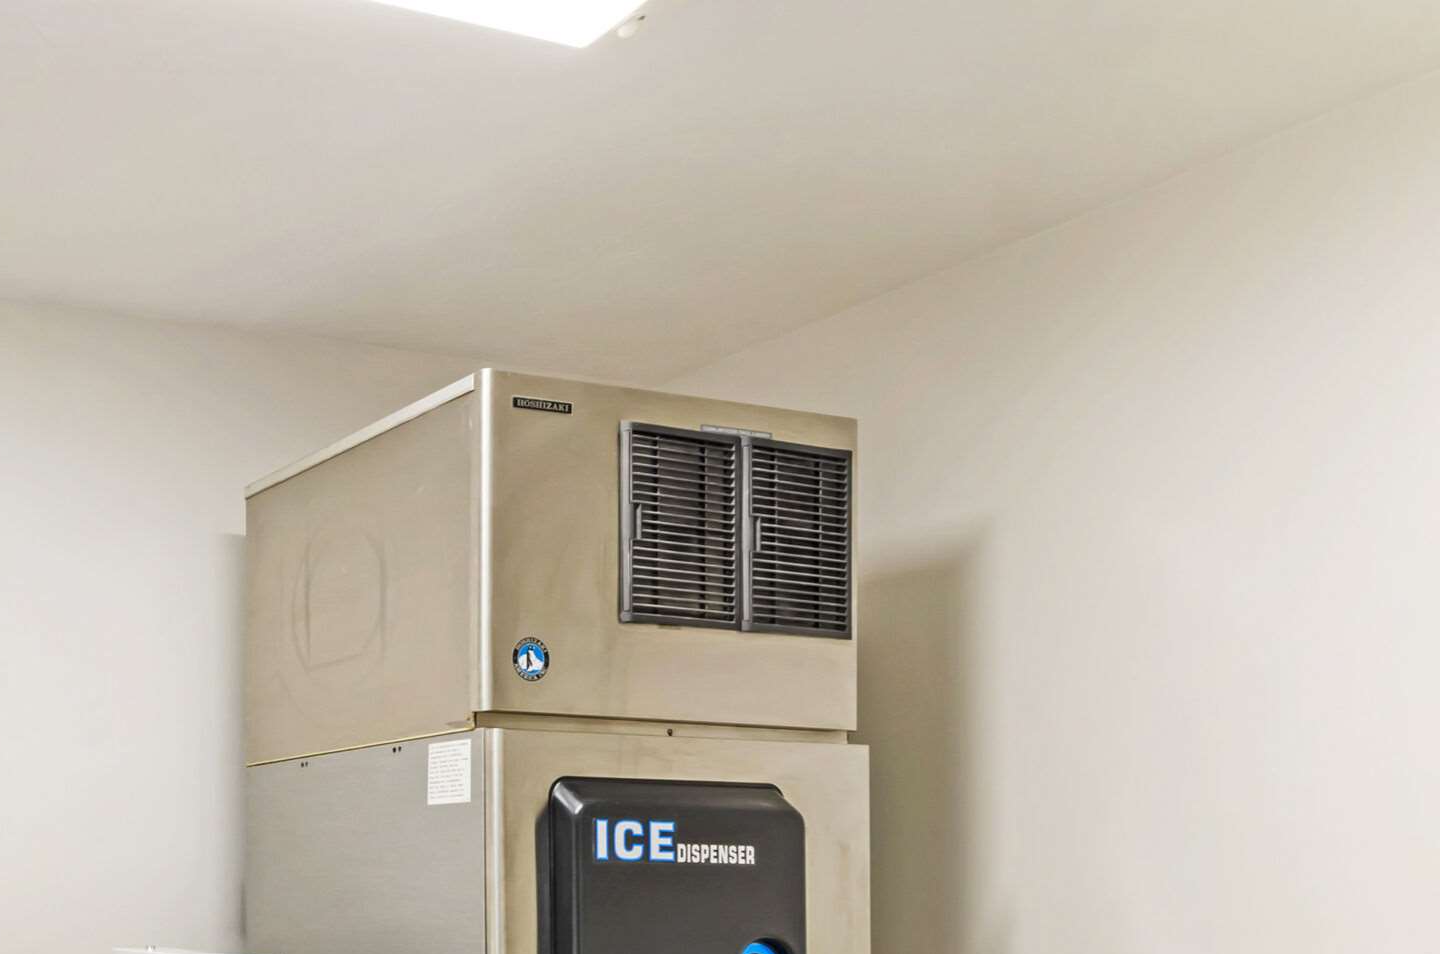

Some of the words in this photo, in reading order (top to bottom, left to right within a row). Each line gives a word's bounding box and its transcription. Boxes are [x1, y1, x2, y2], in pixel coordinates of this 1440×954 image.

[516, 398, 570, 412] HOSHIZAKI
[595, 818, 676, 862] ICE
[676, 843, 756, 865] DISPENSER
